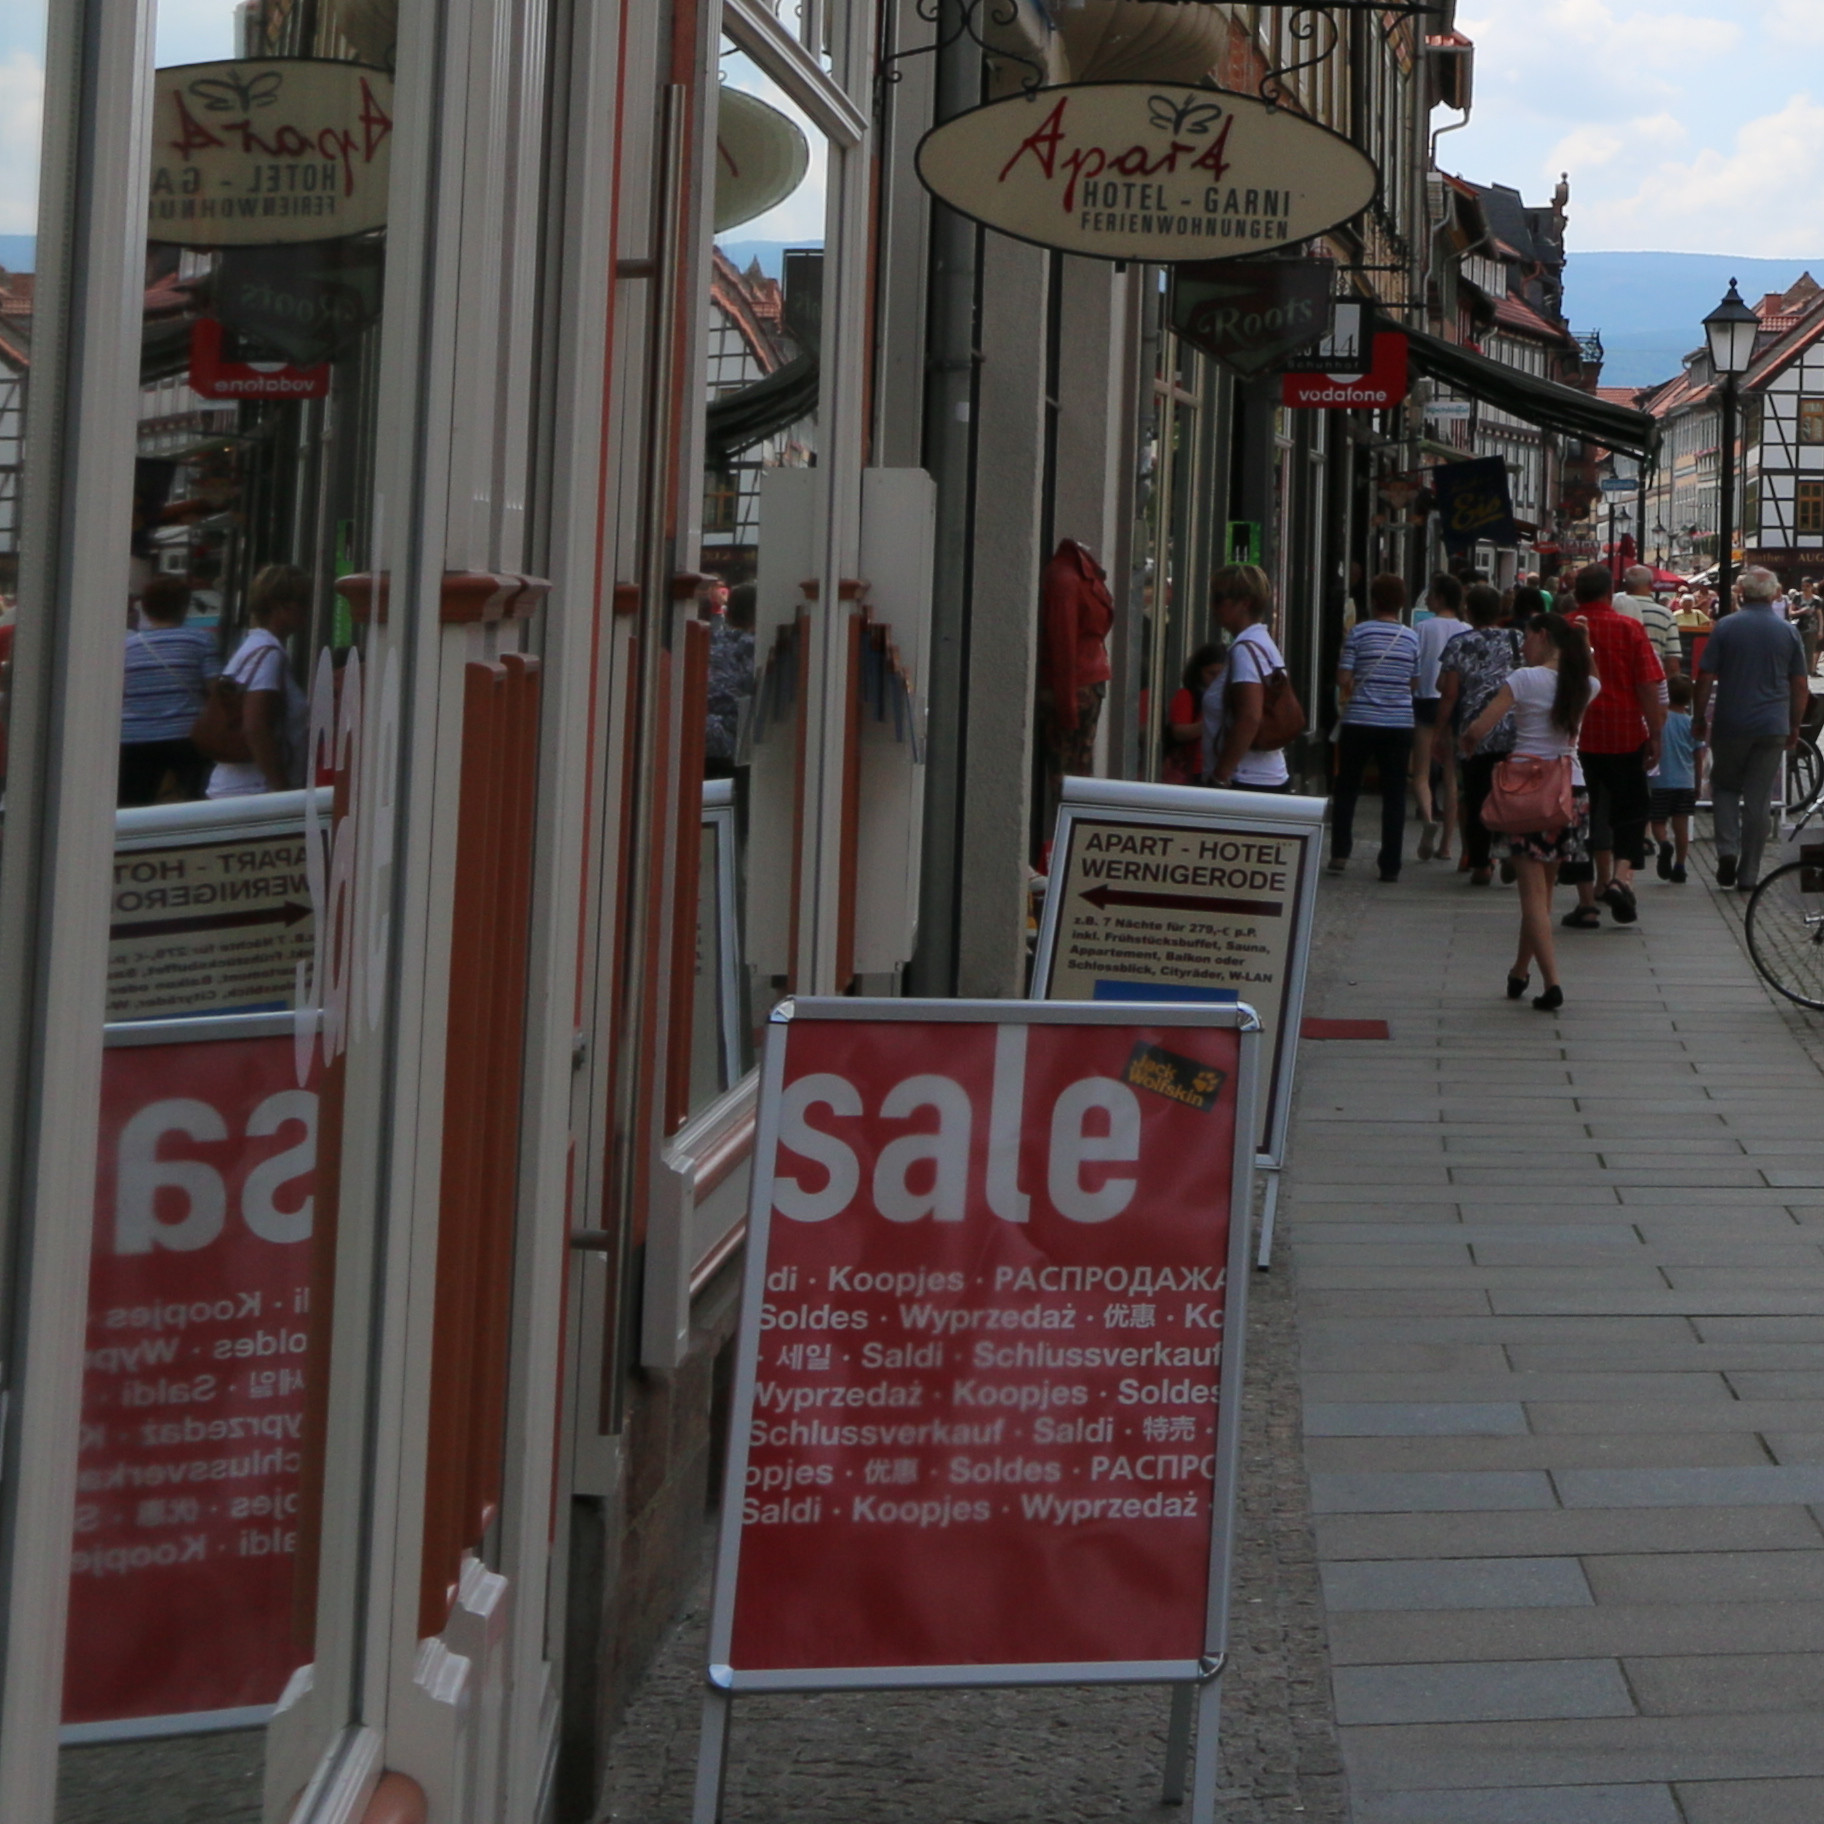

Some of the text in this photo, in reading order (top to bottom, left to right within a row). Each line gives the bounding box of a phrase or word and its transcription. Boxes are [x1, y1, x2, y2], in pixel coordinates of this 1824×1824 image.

[998, 96, 1234, 213] Apart
[1084, 181, 1291, 218] HOTEL GARNI
[1081, 210, 1288, 240] FERIENWOHNUNGEN
[1198, 297, 1314, 348] Roots
[1299, 386, 1387, 402] vodafone
[1085, 832, 1288, 866] APART HOTEL
[1081, 857, 1287, 893] WERNIGERODE
[1072, 930, 1100, 942] inkl.
[1226, 941, 1271, 955] Sauna,
[1115, 918, 1162, 932] Nächte
[1167, 922, 1185, 933] für
[1070, 945, 1246, 967] Appartement, Balkon oder
[1229, 971, 1273, 984] W-LAN
[1131, 1053, 1177, 1078] Jack
[1129, 1066, 1204, 1108] Wolfskin
[771, 1024, 1142, 1224] sale
[828, 1265, 966, 1300] Koopjes
[758, 1305, 869, 1332] Soldes
[900, 1302, 1076, 1336] Wyprzedaż
[1104, 1302, 1156, 1330] 优惠
[776, 1340, 1223, 1371] 세일 Saldi Schlussverkauf
[953, 1378, 1088, 1413] Koopjes
[749, 1418, 1004, 1448] Schlussverkauf
[1033, 1417, 1114, 1444] Saldi
[948, 1457, 1061, 1485] Soldes
[741, 1490, 1198, 1529] Saldi Koopjes Wyprzedaż
